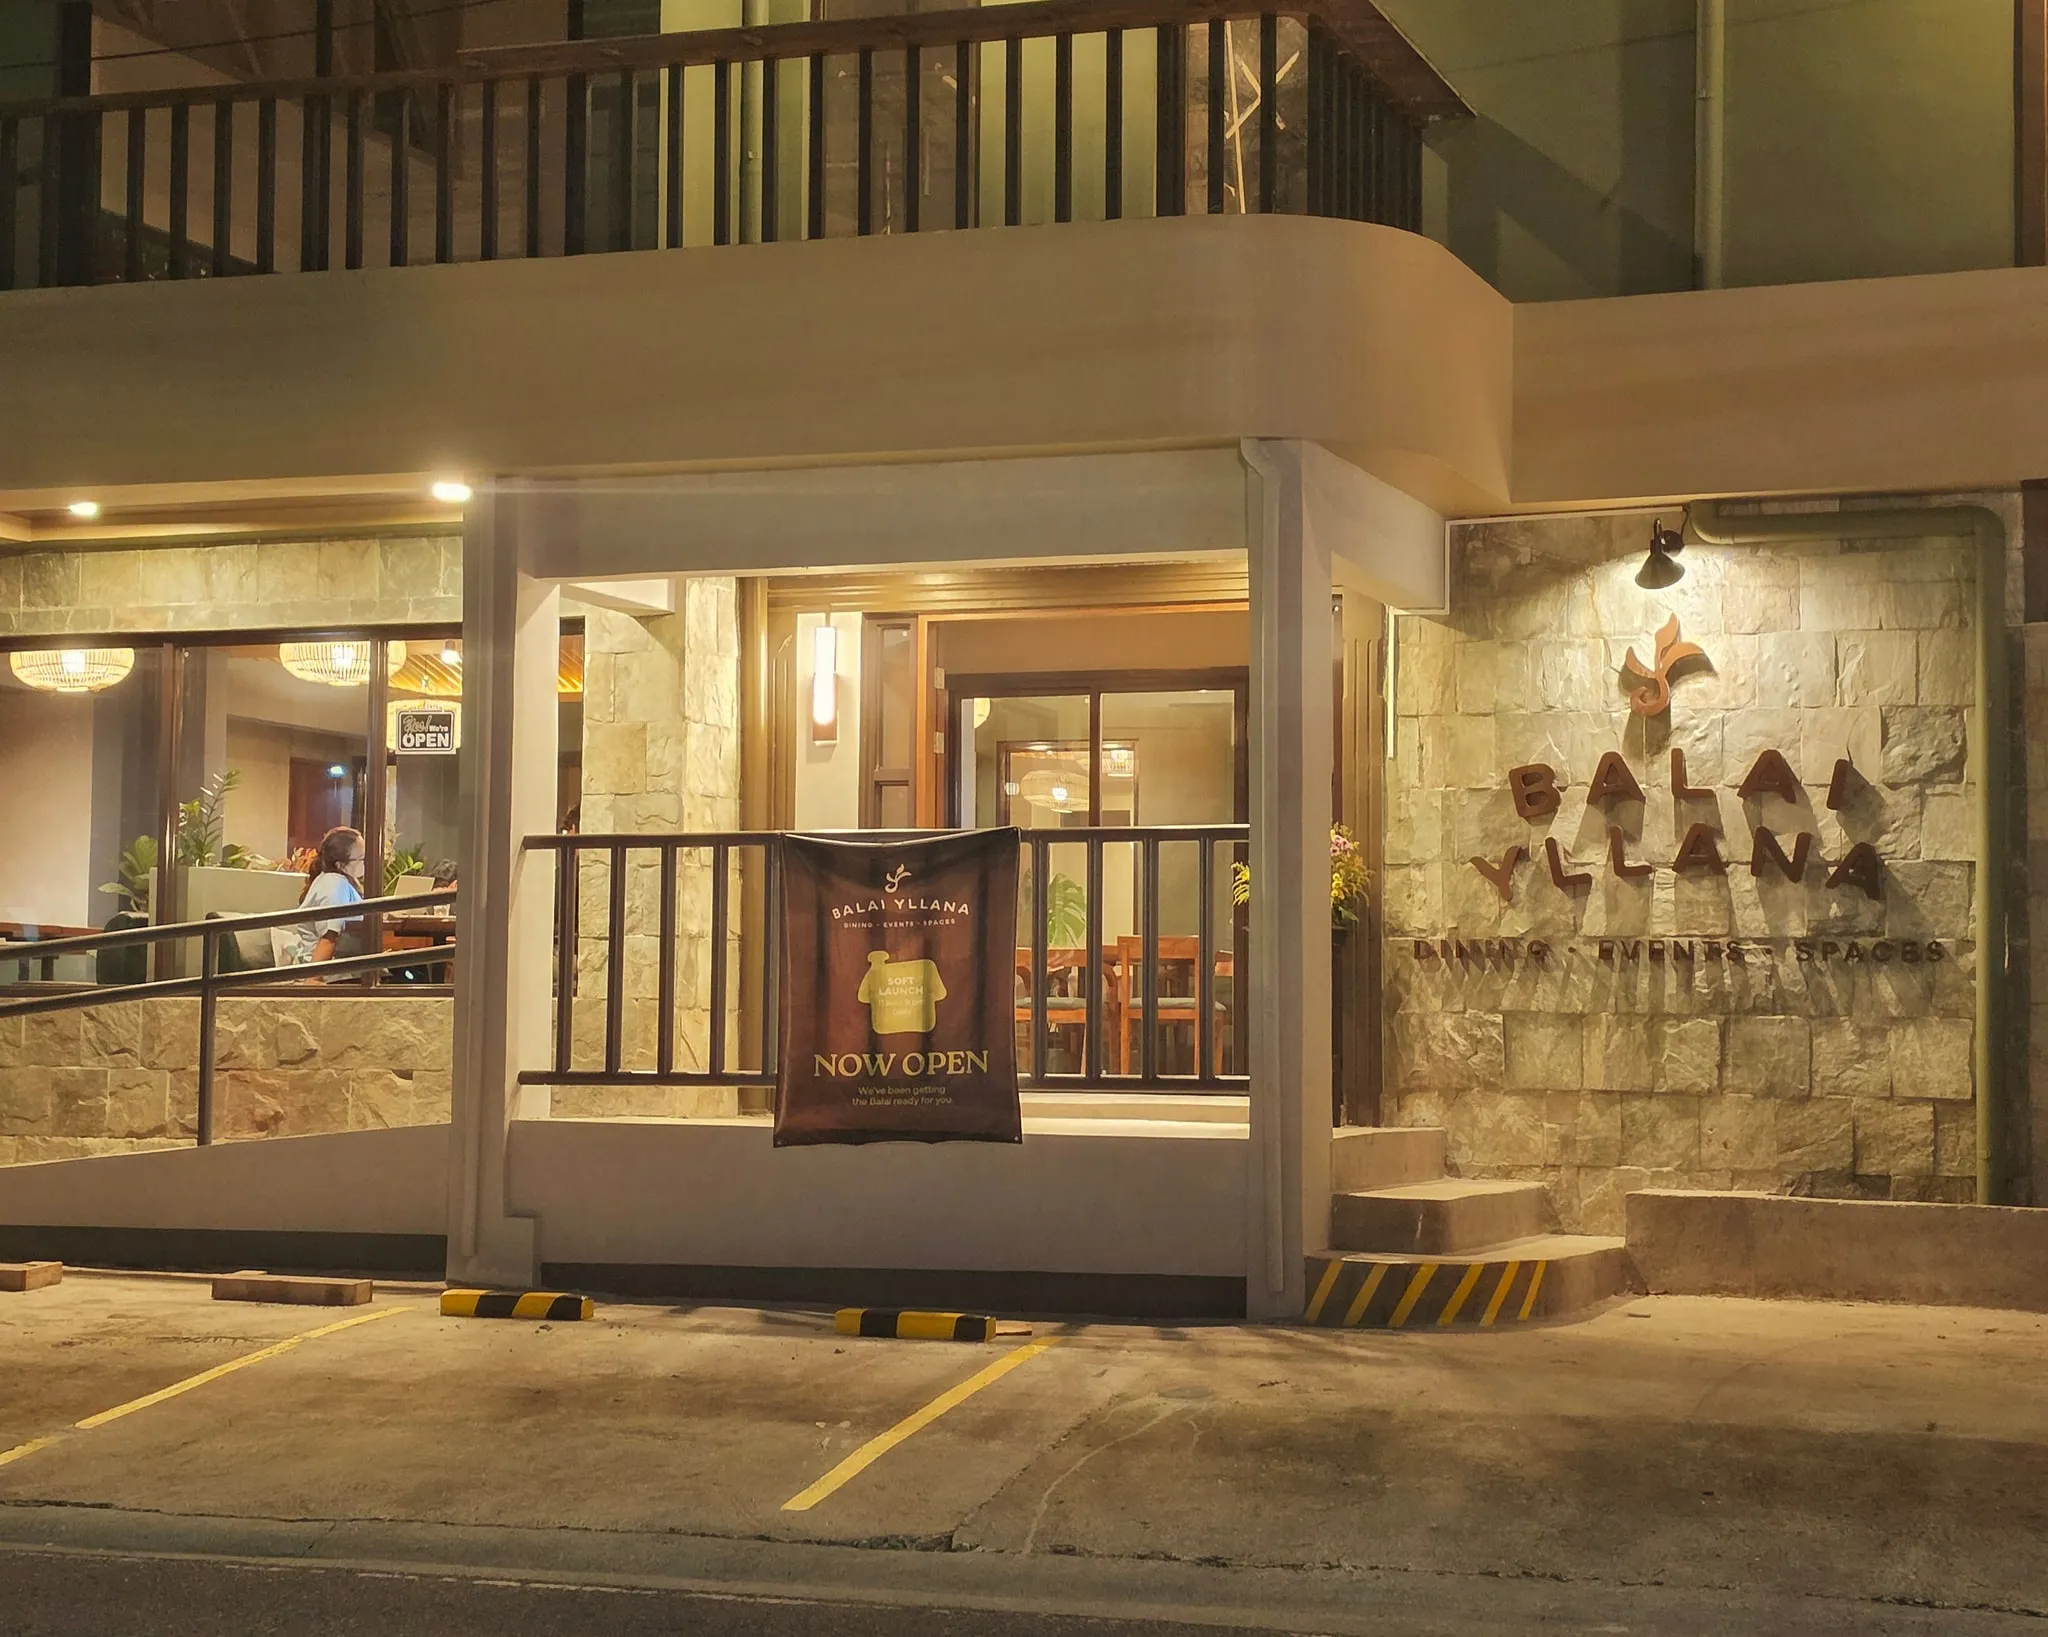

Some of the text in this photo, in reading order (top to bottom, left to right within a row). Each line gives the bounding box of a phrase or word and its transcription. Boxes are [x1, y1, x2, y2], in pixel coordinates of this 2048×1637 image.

[402, 733, 449, 747] OPEN
[1508, 747, 1853, 819] BALAI
[1470, 822, 1886, 901] YLLANA
[832, 898, 970, 919] BALAI YLLANA
[1413, 939, 1945, 963] DINING EVENTS SPACES
[887, 976, 914, 985] SOFT
[878, 986, 923, 996] LAUNCH
[814, 1050, 989, 1077] NOW OPEN
[858, 1086, 946, 1096] We've been getting
[852, 1097, 868, 1105] the
[869, 1097, 892, 1105] Balai
[893, 1097, 919, 1106] ready
[921, 1096, 934, 1105] for
